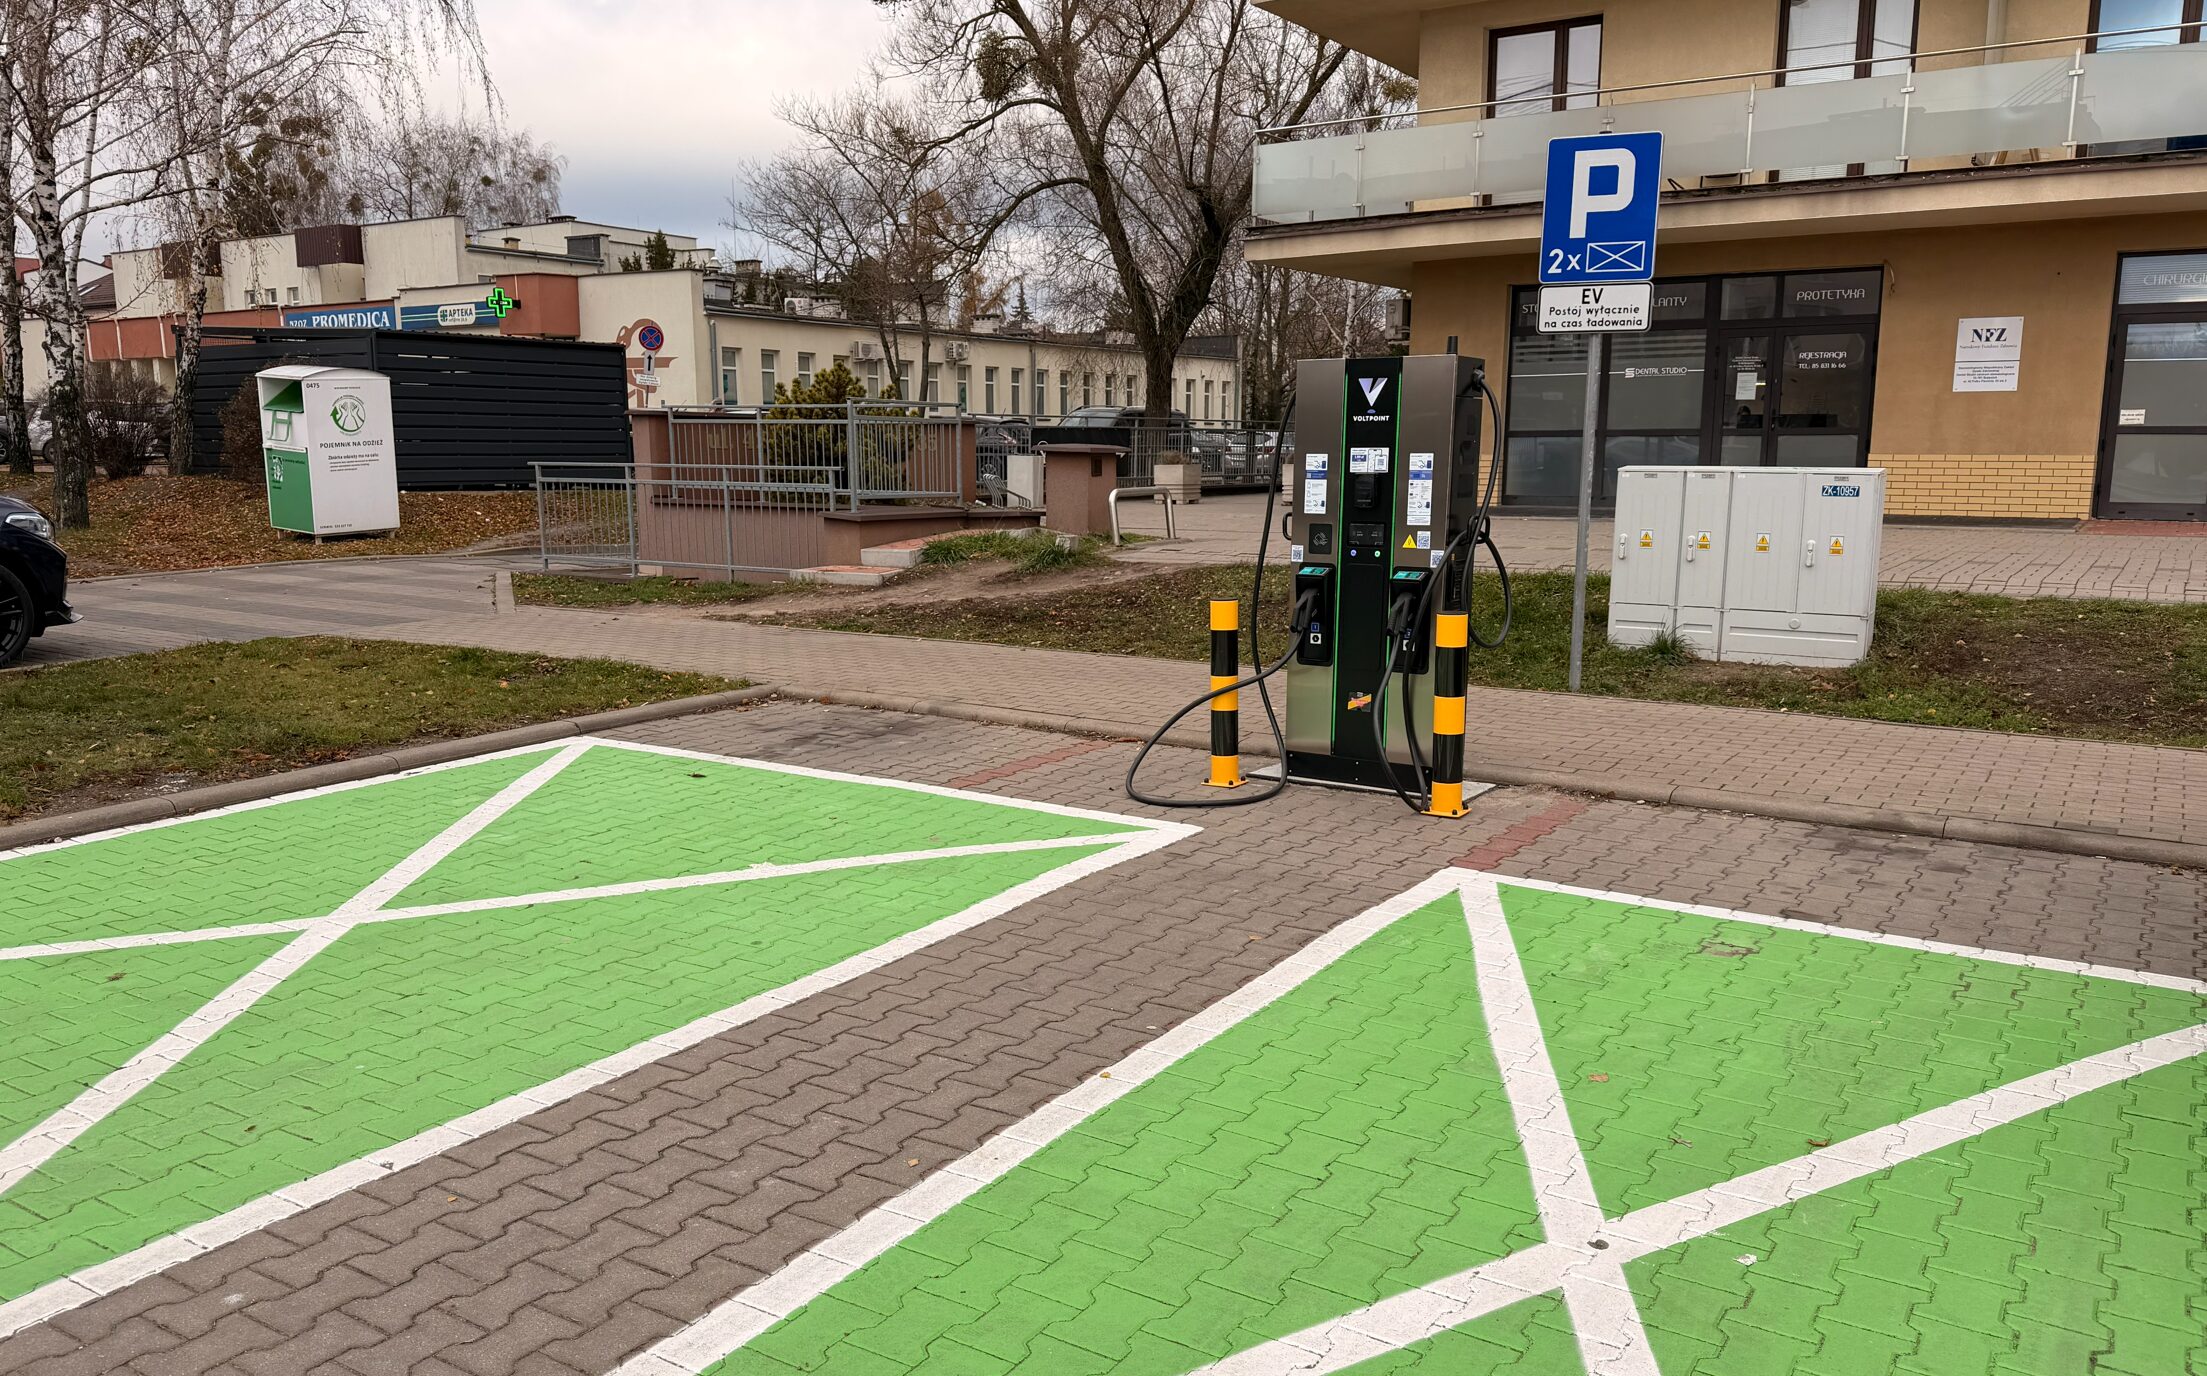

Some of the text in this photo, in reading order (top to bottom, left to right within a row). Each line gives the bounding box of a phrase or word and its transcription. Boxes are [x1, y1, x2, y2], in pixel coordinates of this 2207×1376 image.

[1569, 147, 1637, 239] P
[2143, 272, 2207, 286] CHIRURGI
[1581, 287, 1604, 305] EV
[1796, 288, 1866, 301] PROTETYKA
[448, 308, 474, 317] APTEKA
[1549, 304, 1640, 317] Postój wyłącznie
[311, 311, 391, 328] PROMEDICA
[1544, 317, 1642, 328] na czas ładowania
[1971, 327, 2008, 343] NFZ
[1799, 351, 1847, 360] REJESTRACJA
[1635, 367, 1660, 375] DENTAL
[1661, 366, 1688, 374] STUDIO
[319, 441, 351, 449] POJEMNIK
[1822, 485, 1859, 497] ZK-10957
